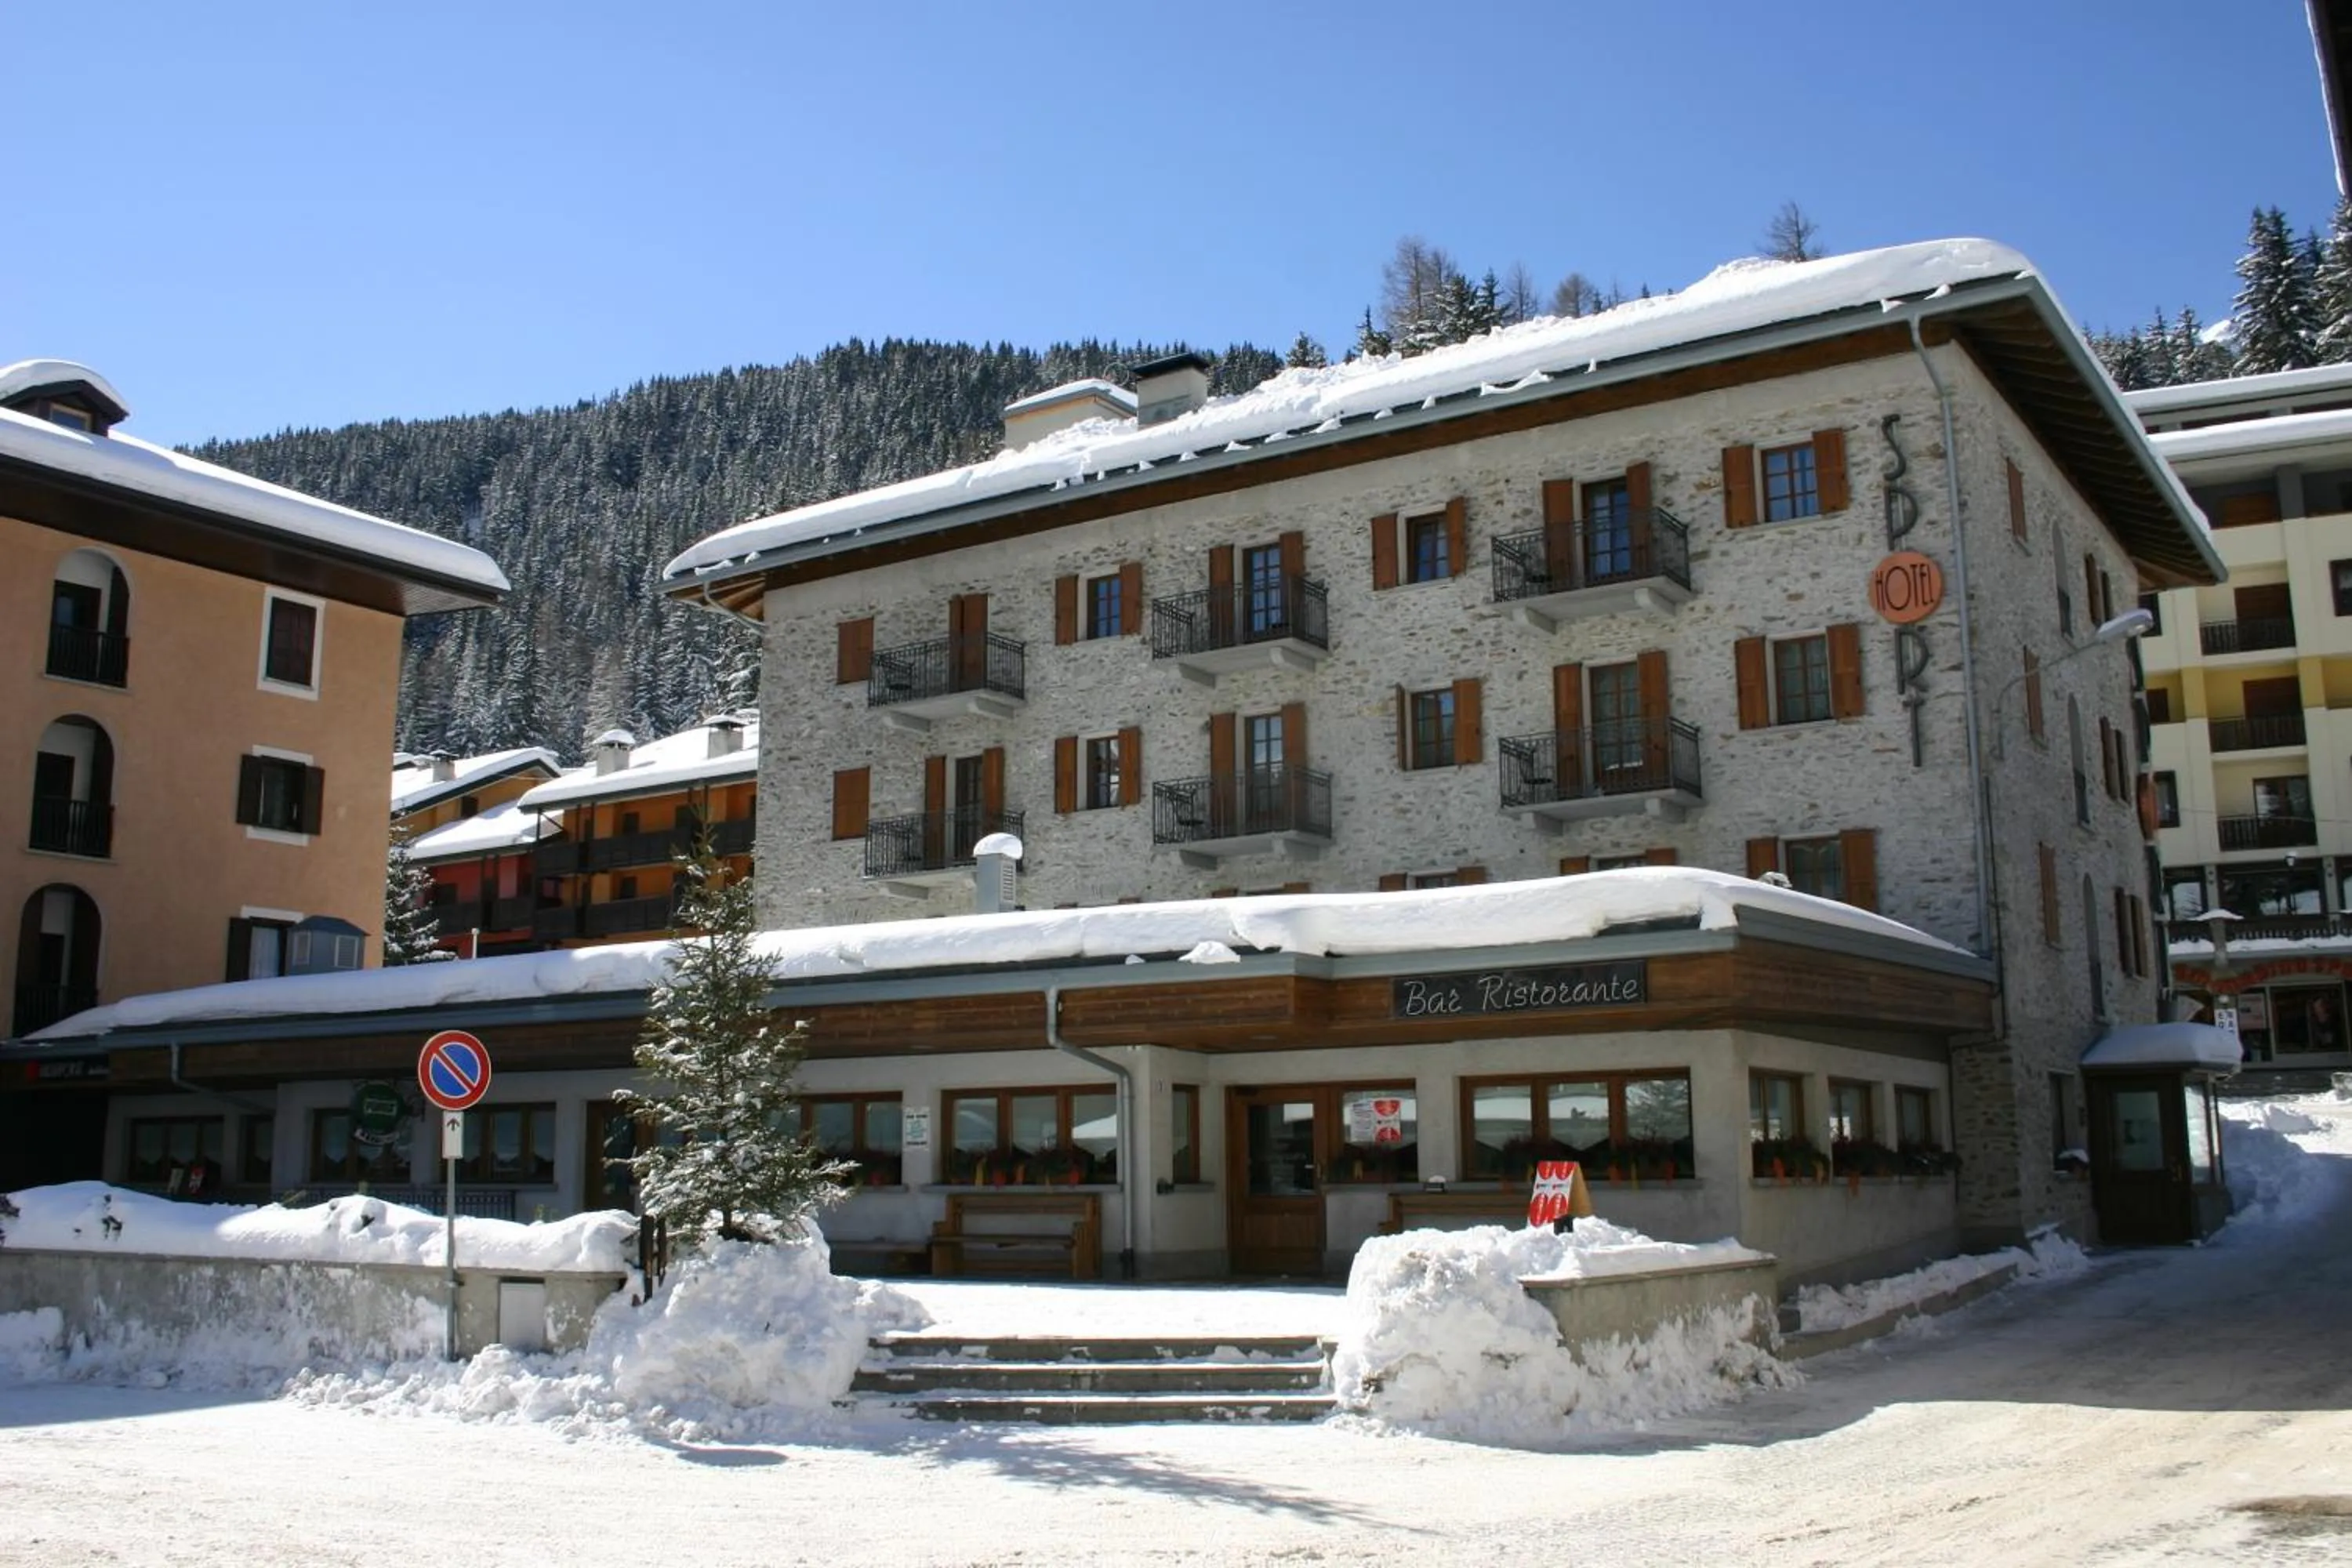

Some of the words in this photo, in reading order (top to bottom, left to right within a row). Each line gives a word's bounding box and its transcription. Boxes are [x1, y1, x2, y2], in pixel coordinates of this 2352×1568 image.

[1875, 564, 1934, 612] HOTEL
[1403, 981, 1462, 1016] Bar
[1478, 974, 1639, 1011] Ristorante
